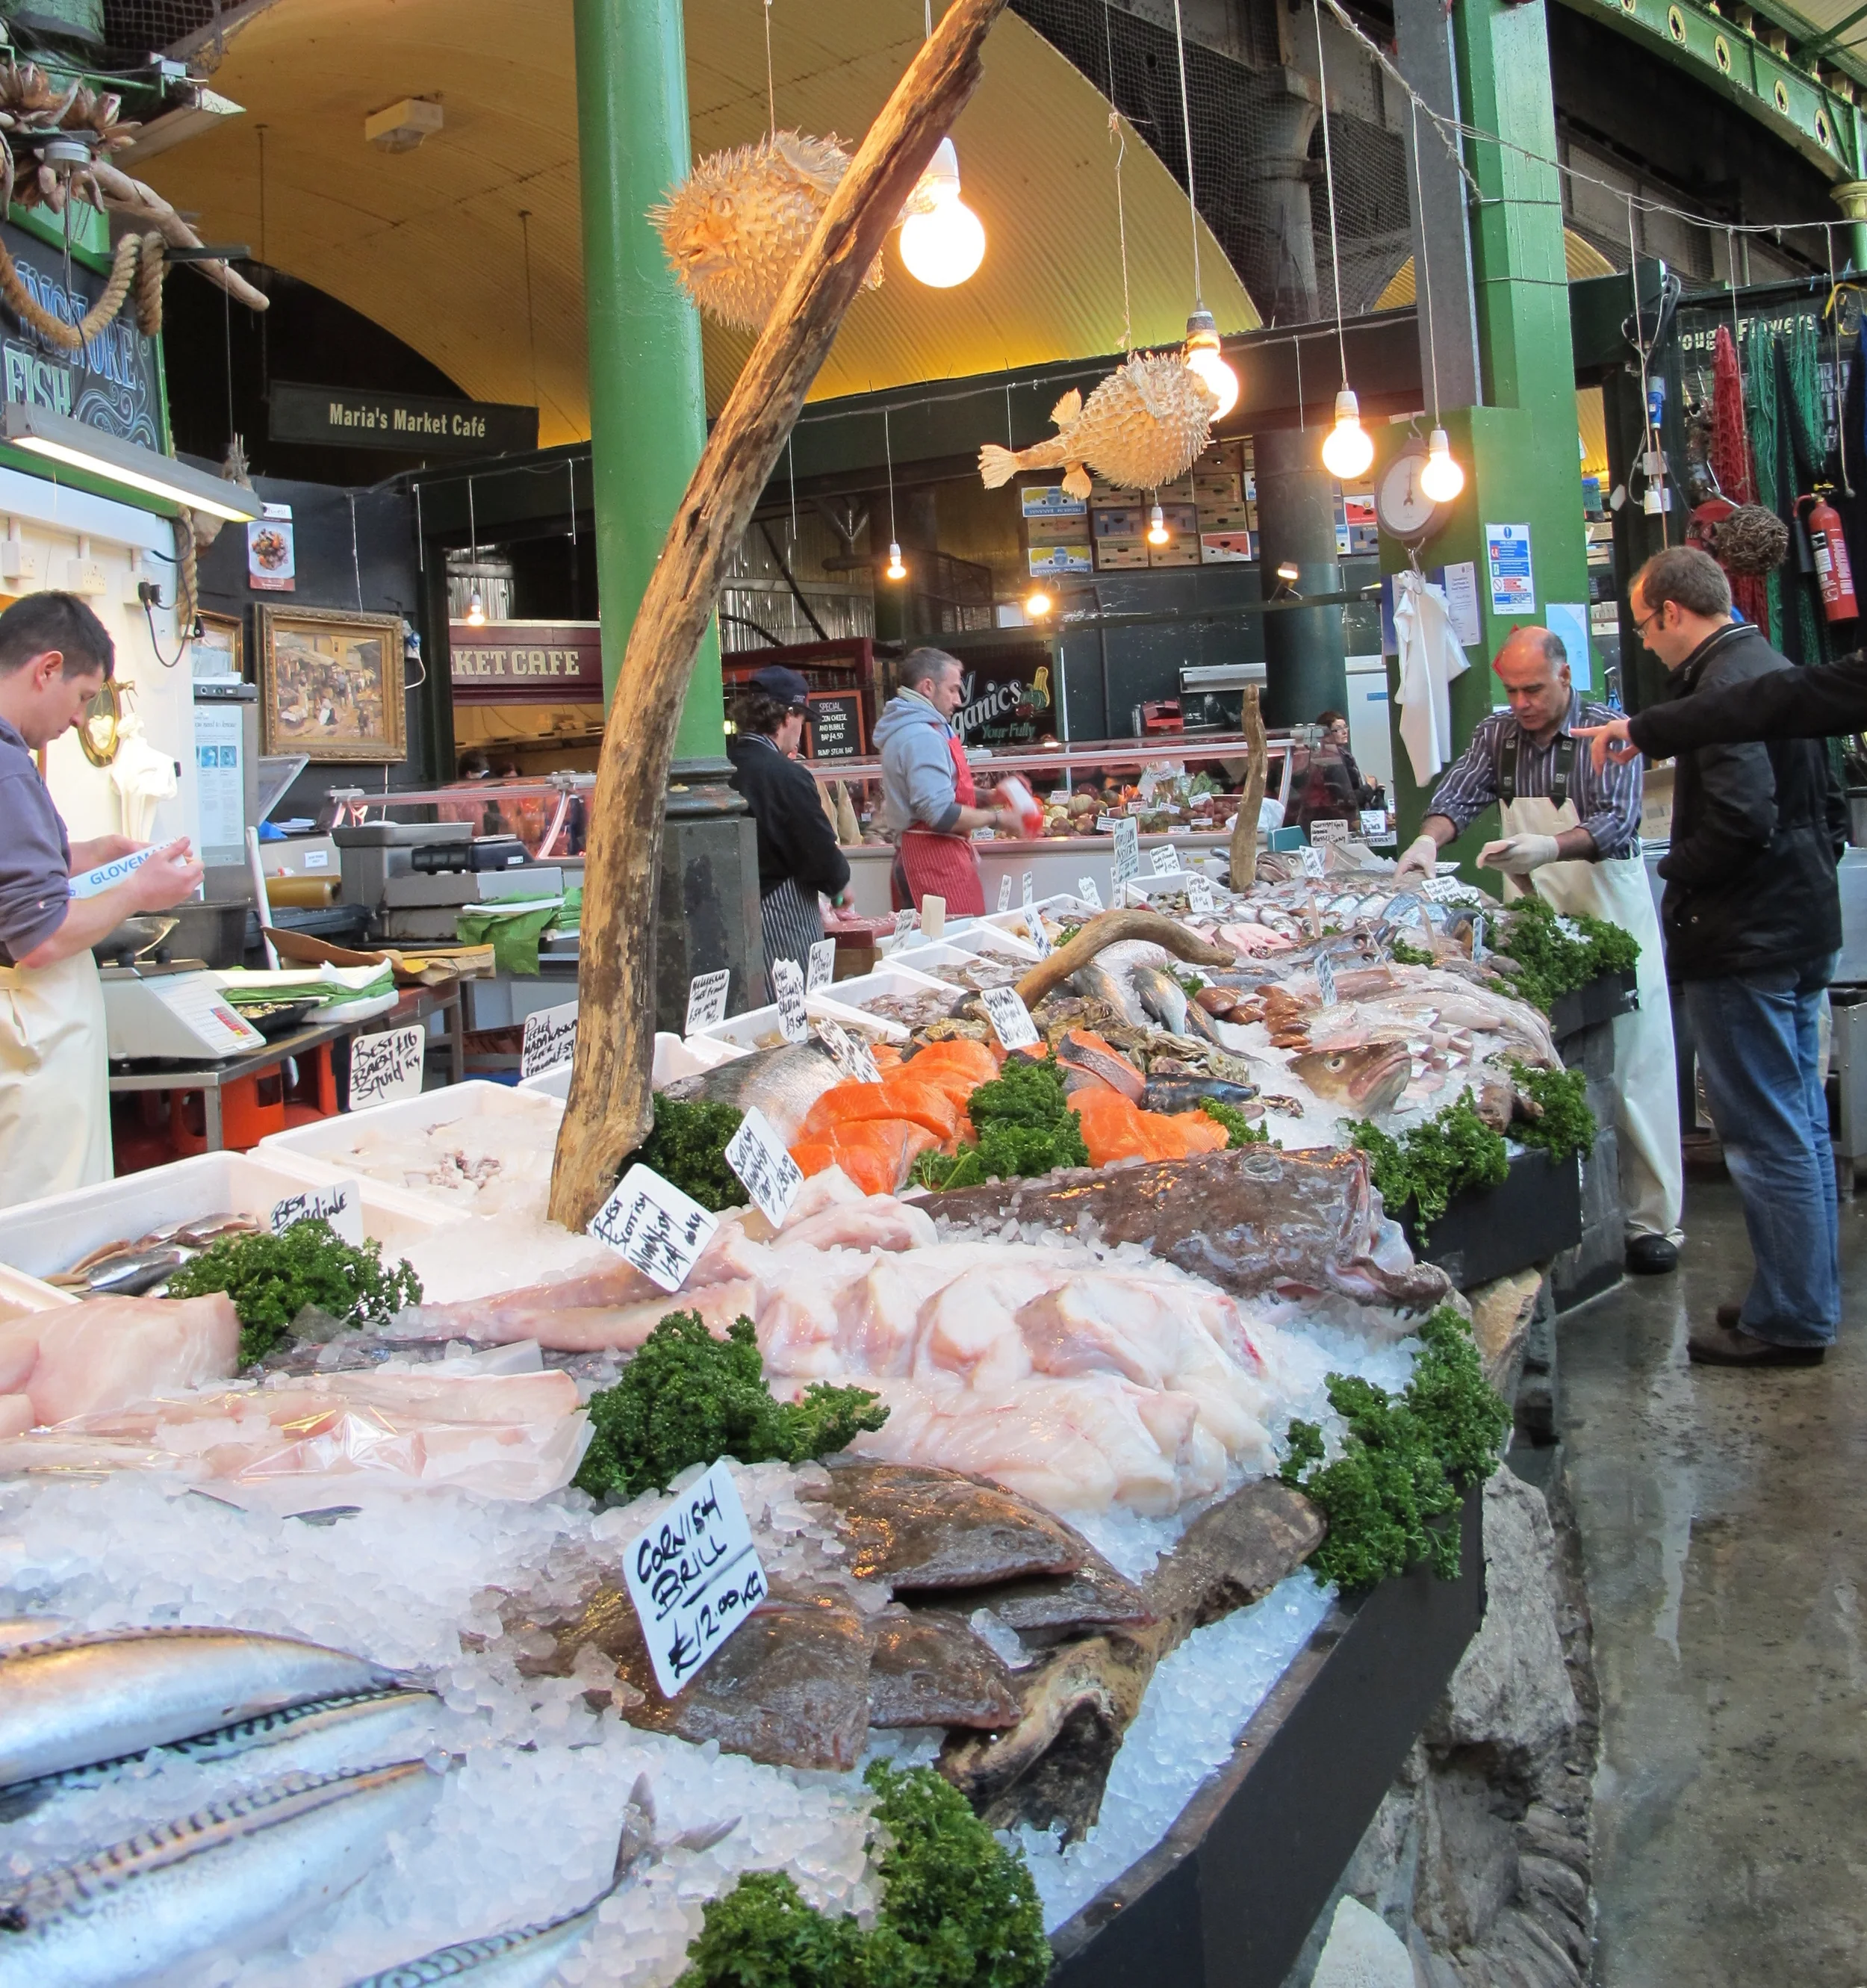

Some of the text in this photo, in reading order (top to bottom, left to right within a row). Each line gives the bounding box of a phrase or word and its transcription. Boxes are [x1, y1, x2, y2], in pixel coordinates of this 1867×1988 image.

[4, 343, 72, 415] FISH
[329, 403, 485, 438] Maria's Market Café
[450, 650, 580, 676] KET CAFE
[951, 681, 1022, 745] ganics
[637, 1478, 723, 1584] CORNISH
[652, 1535, 727, 1621] BRILL
